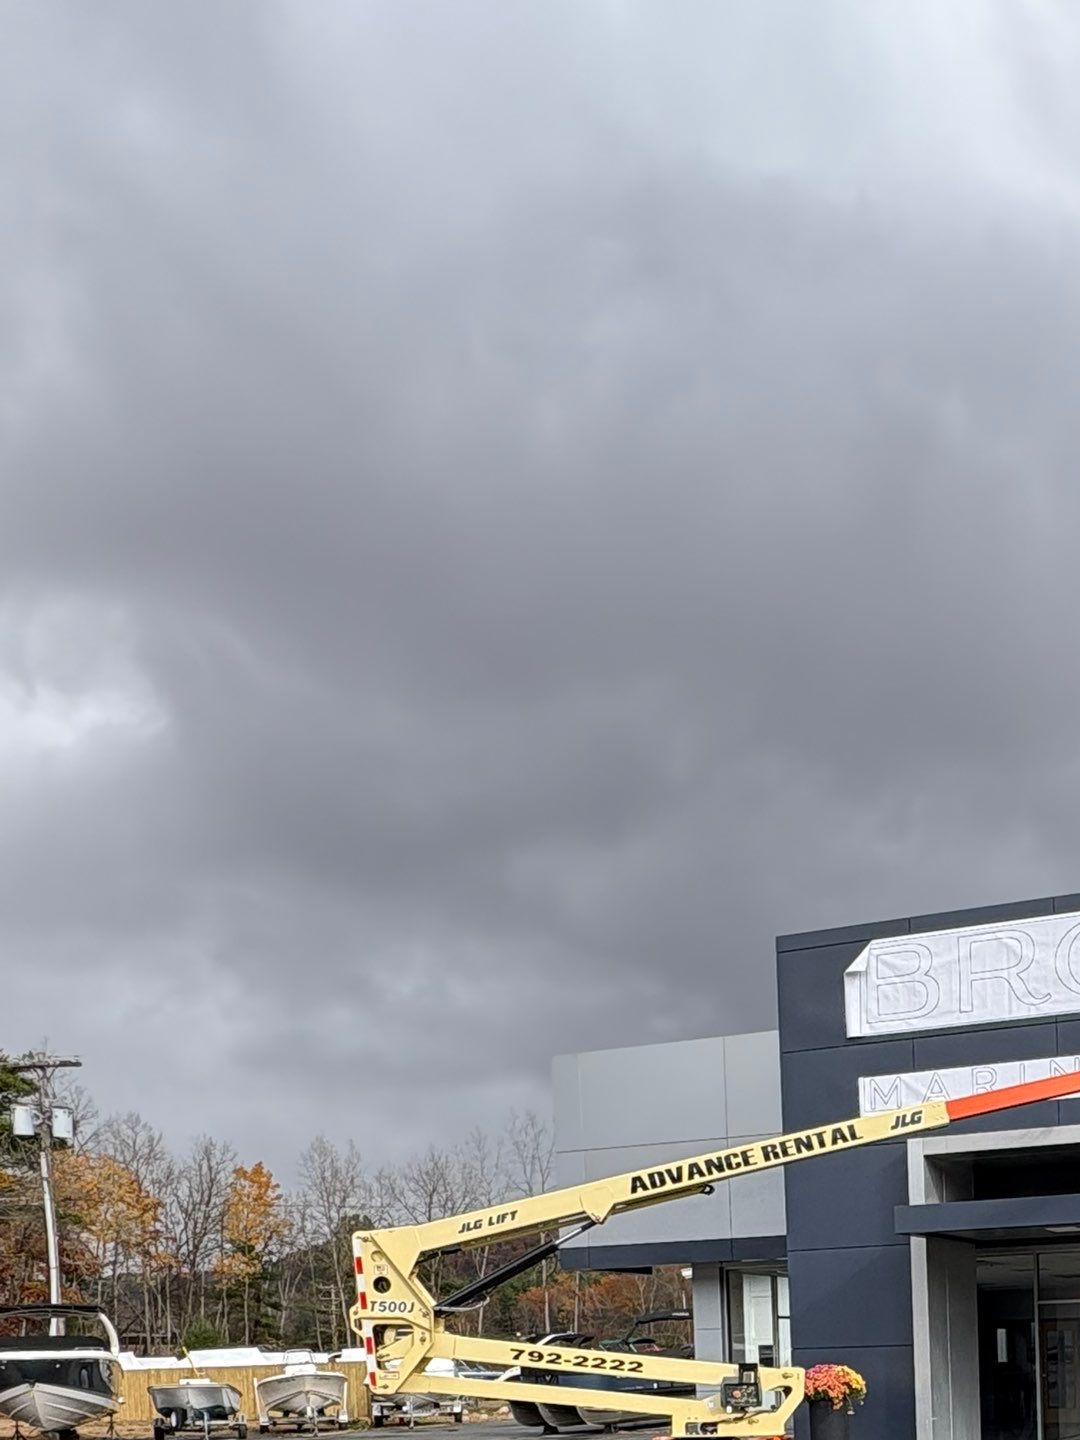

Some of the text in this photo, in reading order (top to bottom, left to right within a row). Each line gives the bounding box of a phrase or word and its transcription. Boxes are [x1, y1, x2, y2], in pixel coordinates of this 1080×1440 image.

[890, 1110, 922, 1130] JLG
[630, 1124, 864, 1194] ADVANCE RENTAL
[458, 1210, 518, 1234] JLG LIFT
[370, 1300, 415, 1313] T500J
[510, 1348, 644, 1373] 792-2222
